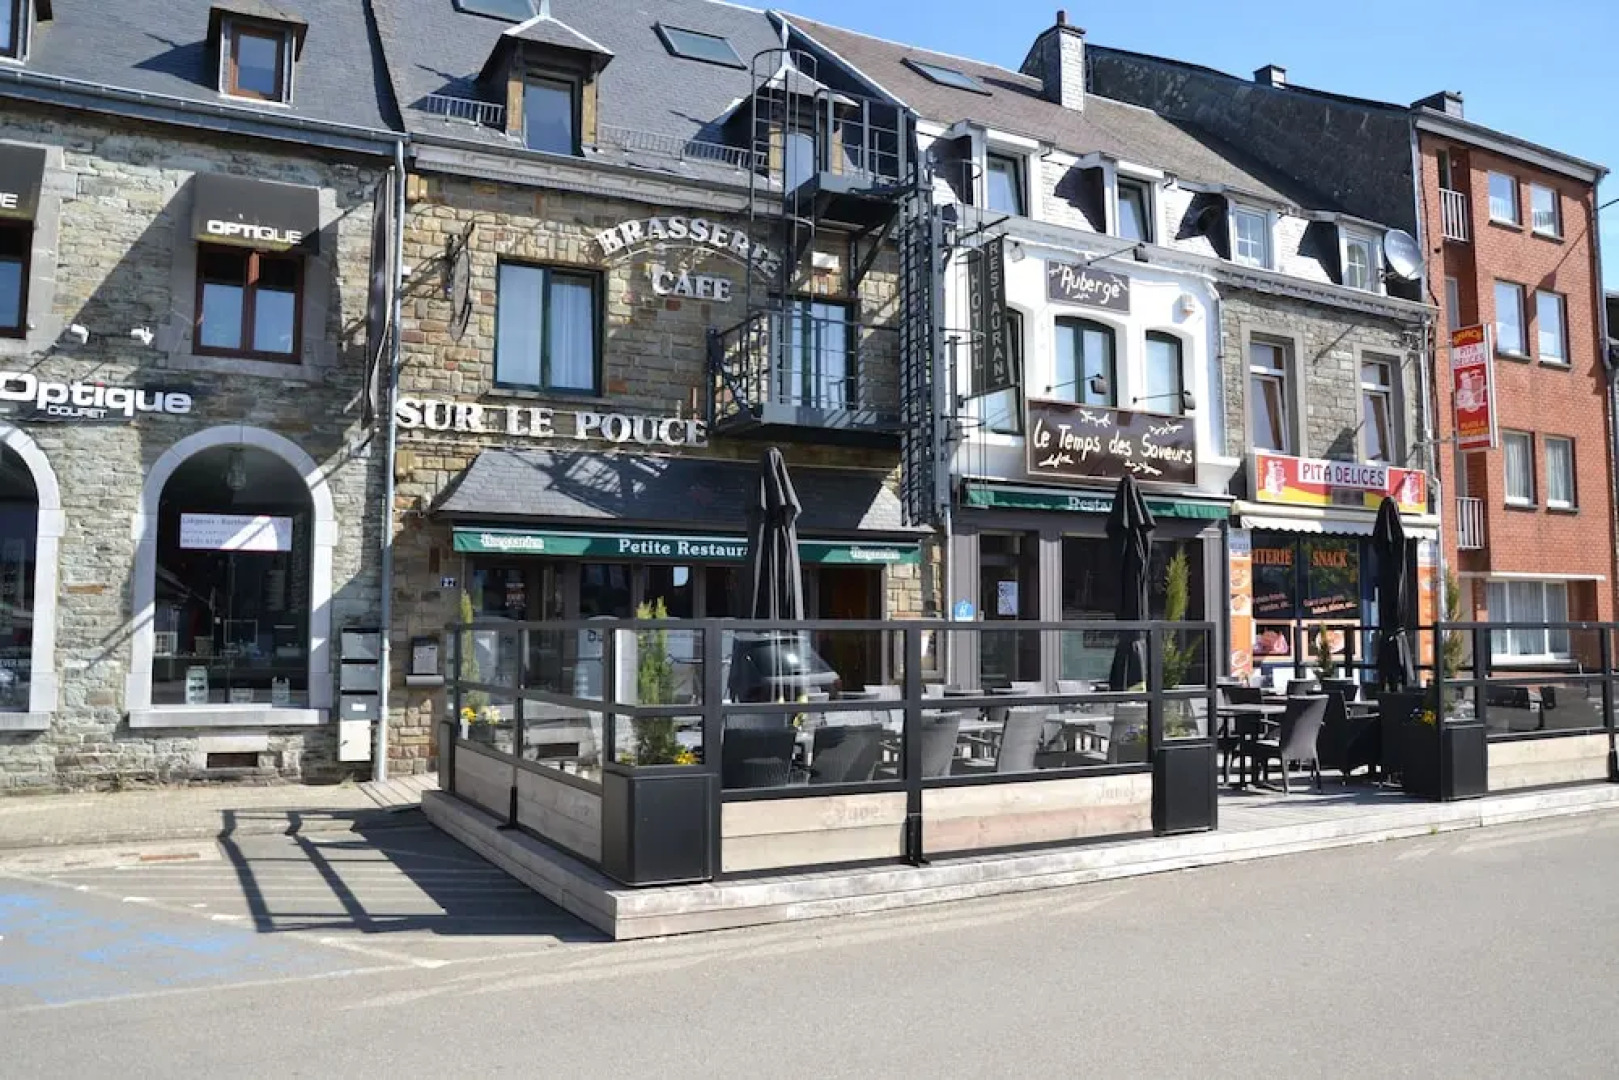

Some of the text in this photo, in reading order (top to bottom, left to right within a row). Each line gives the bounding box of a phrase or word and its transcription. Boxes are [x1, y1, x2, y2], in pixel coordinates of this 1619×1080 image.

[206, 219, 302, 244] OPTIQUE
[648, 263, 732, 302] CAFE
[971, 272, 984, 370] HOTEL
[989, 241, 1005, 385] RESTAURANT
[0, 371, 192, 417] Optique
[396, 399, 709, 447] SUR LE POUCE
[1033, 418, 1051, 449] Le
[1058, 423, 1101, 460] Temps
[1109, 429, 1133, 457] des
[1302, 462, 1385, 487] PITA DELICES
[619, 538, 671, 555] Petite
[1312, 548, 1348, 568] SNACK
